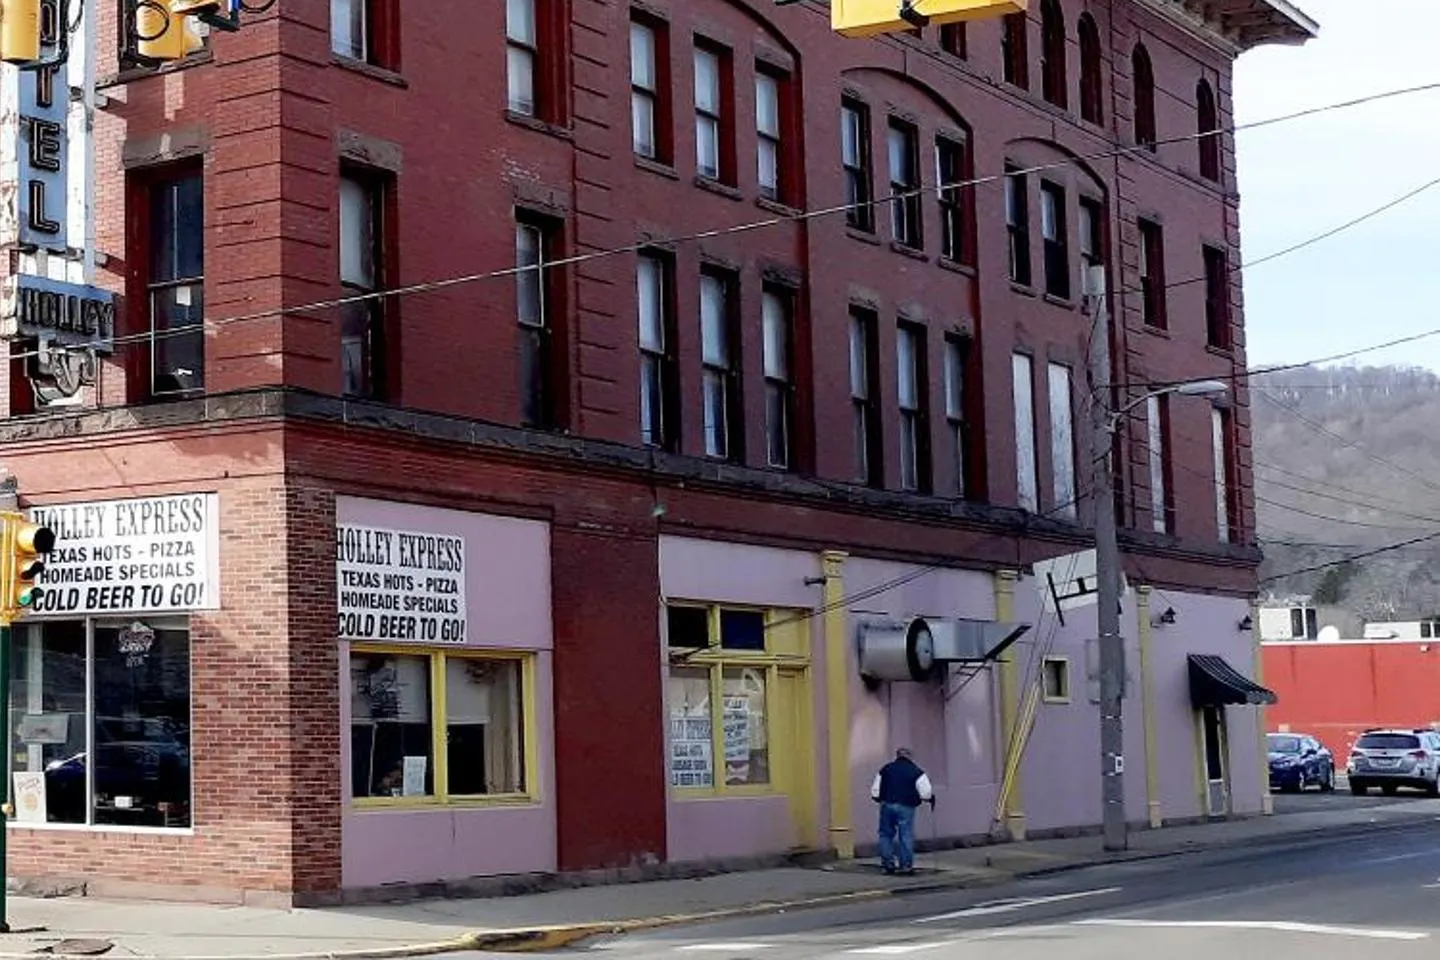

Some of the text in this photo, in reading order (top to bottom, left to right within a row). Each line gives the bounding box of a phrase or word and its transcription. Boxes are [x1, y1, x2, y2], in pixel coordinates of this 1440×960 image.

[21, 287, 113, 336] HOLLEY
[115, 497, 204, 537] EXPRESS
[92, 544, 132, 561] HOTS
[150, 541, 196, 558] PIZZA
[336, 527, 462, 572] HOLLEY EXPRESS
[40, 562, 195, 585] HOMEADE SPECIALS
[341, 570, 381, 589] TEXAS
[384, 573, 414, 591] HOTS
[426, 577, 458, 594] PIZZA
[32, 582, 204, 612] COLD BEER TO GO!
[341, 591, 458, 615] HOMEADE SPECIALS
[338, 612, 465, 642] COLD BEER TO GO!
